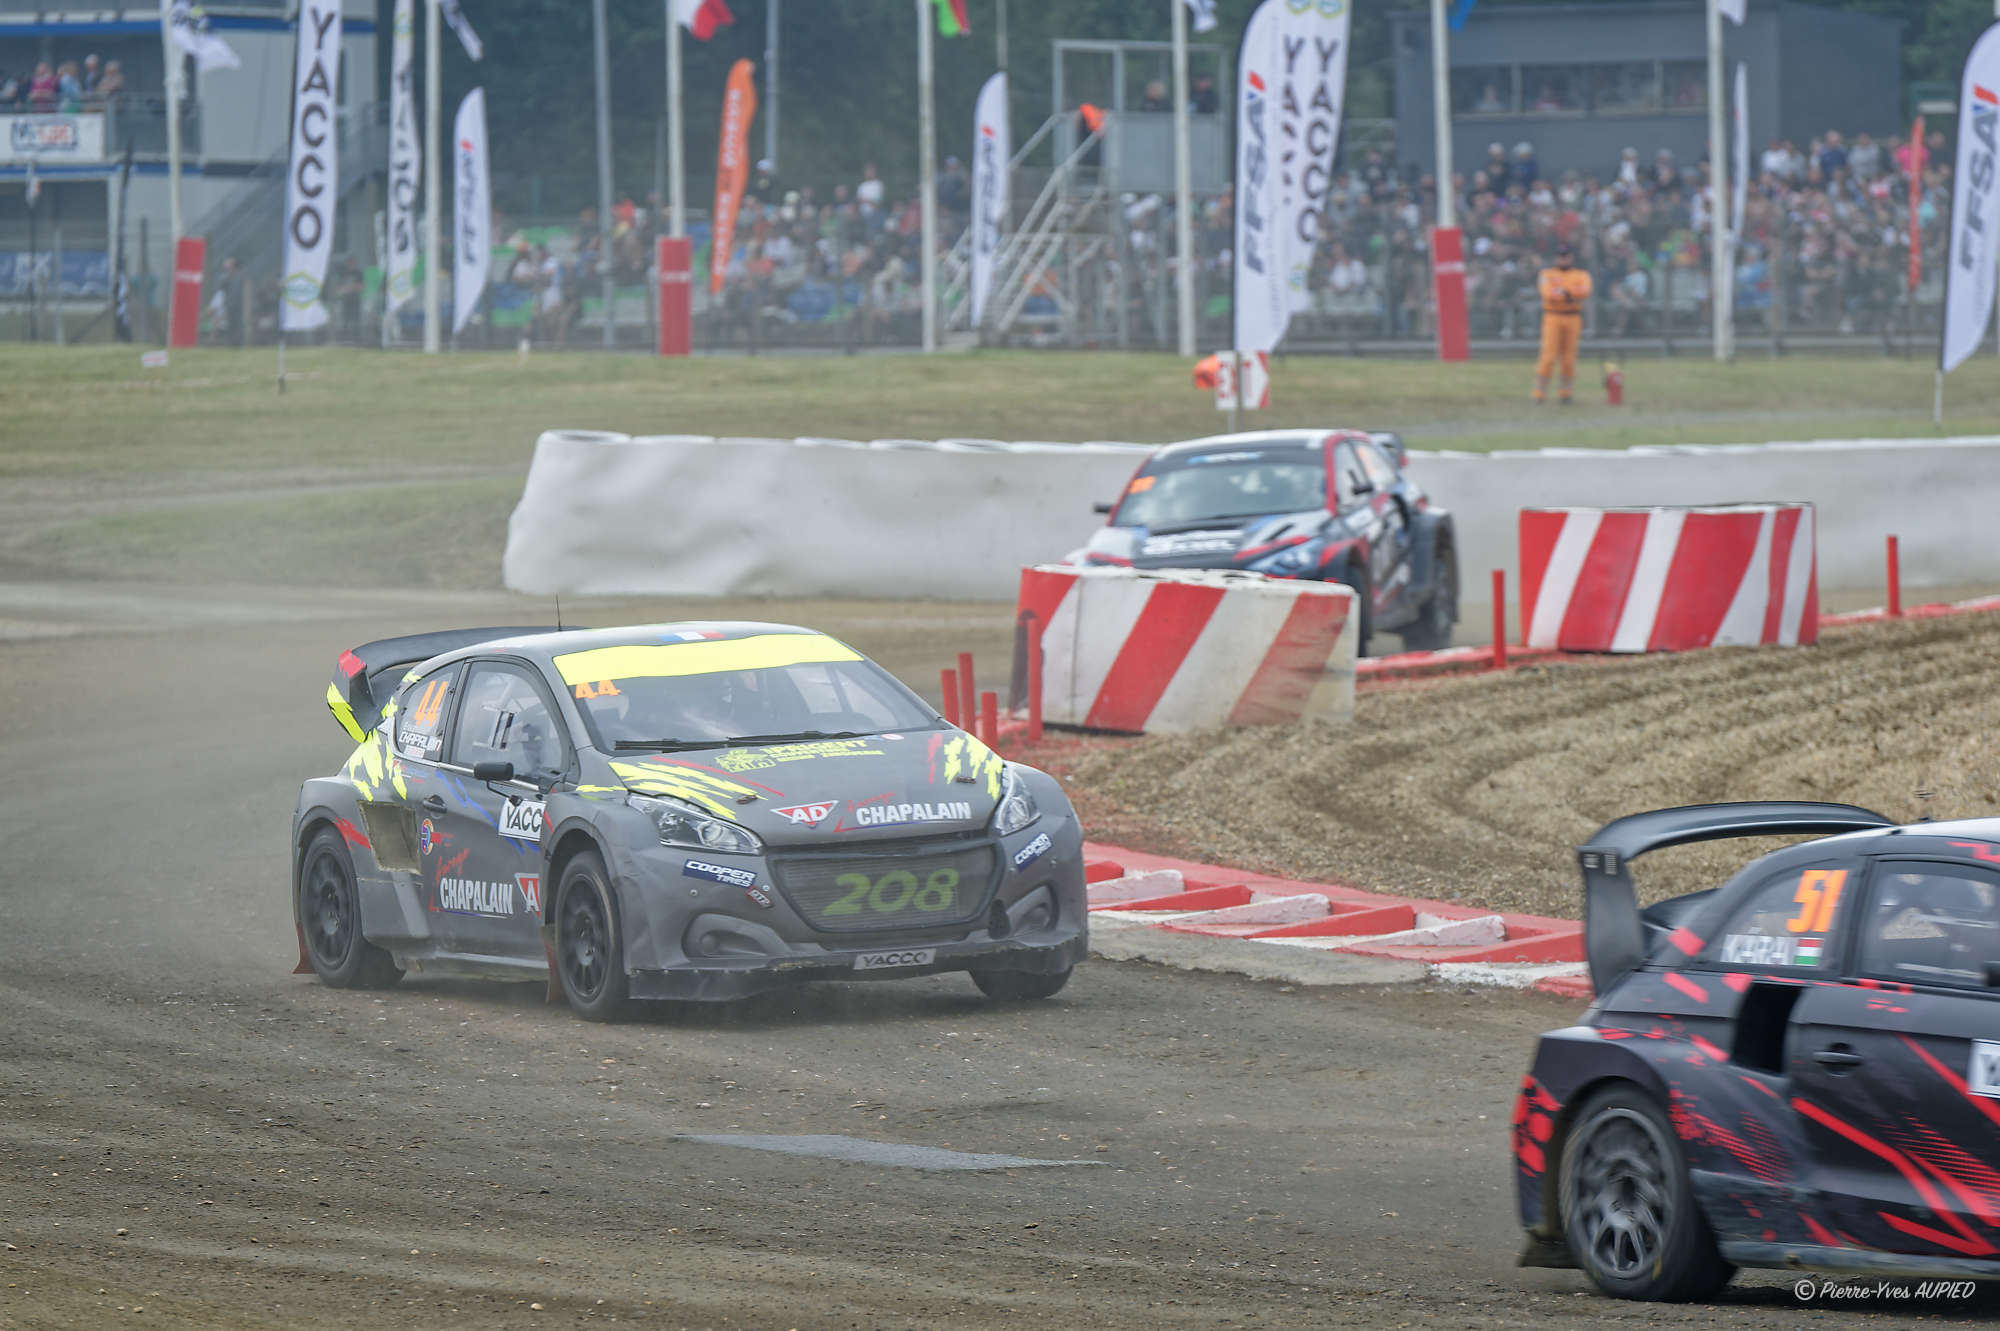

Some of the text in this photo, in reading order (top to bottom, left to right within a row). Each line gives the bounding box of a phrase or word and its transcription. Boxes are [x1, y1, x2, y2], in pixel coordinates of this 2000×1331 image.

[291, 6, 335, 250] YACCO
[1296, 36, 1339, 243] YACCO
[1243, 95, 1268, 275] FFSA
[1959, 106, 1998, 271] FFSA
[414, 680, 448, 727] 44
[576, 680, 621, 699] 44
[791, 806, 829, 824] AD
[856, 801, 972, 825] CHAPALAIN
[1014, 832, 1049, 865] COOPER
[686, 860, 755, 881] COOPER
[716, 874, 752, 888] TIRES
[440, 877, 513, 914] CHAPALAIN
[823, 868, 960, 916] 208
[1786, 869, 1848, 932] 51
[863, 952, 928, 967] YACCO
